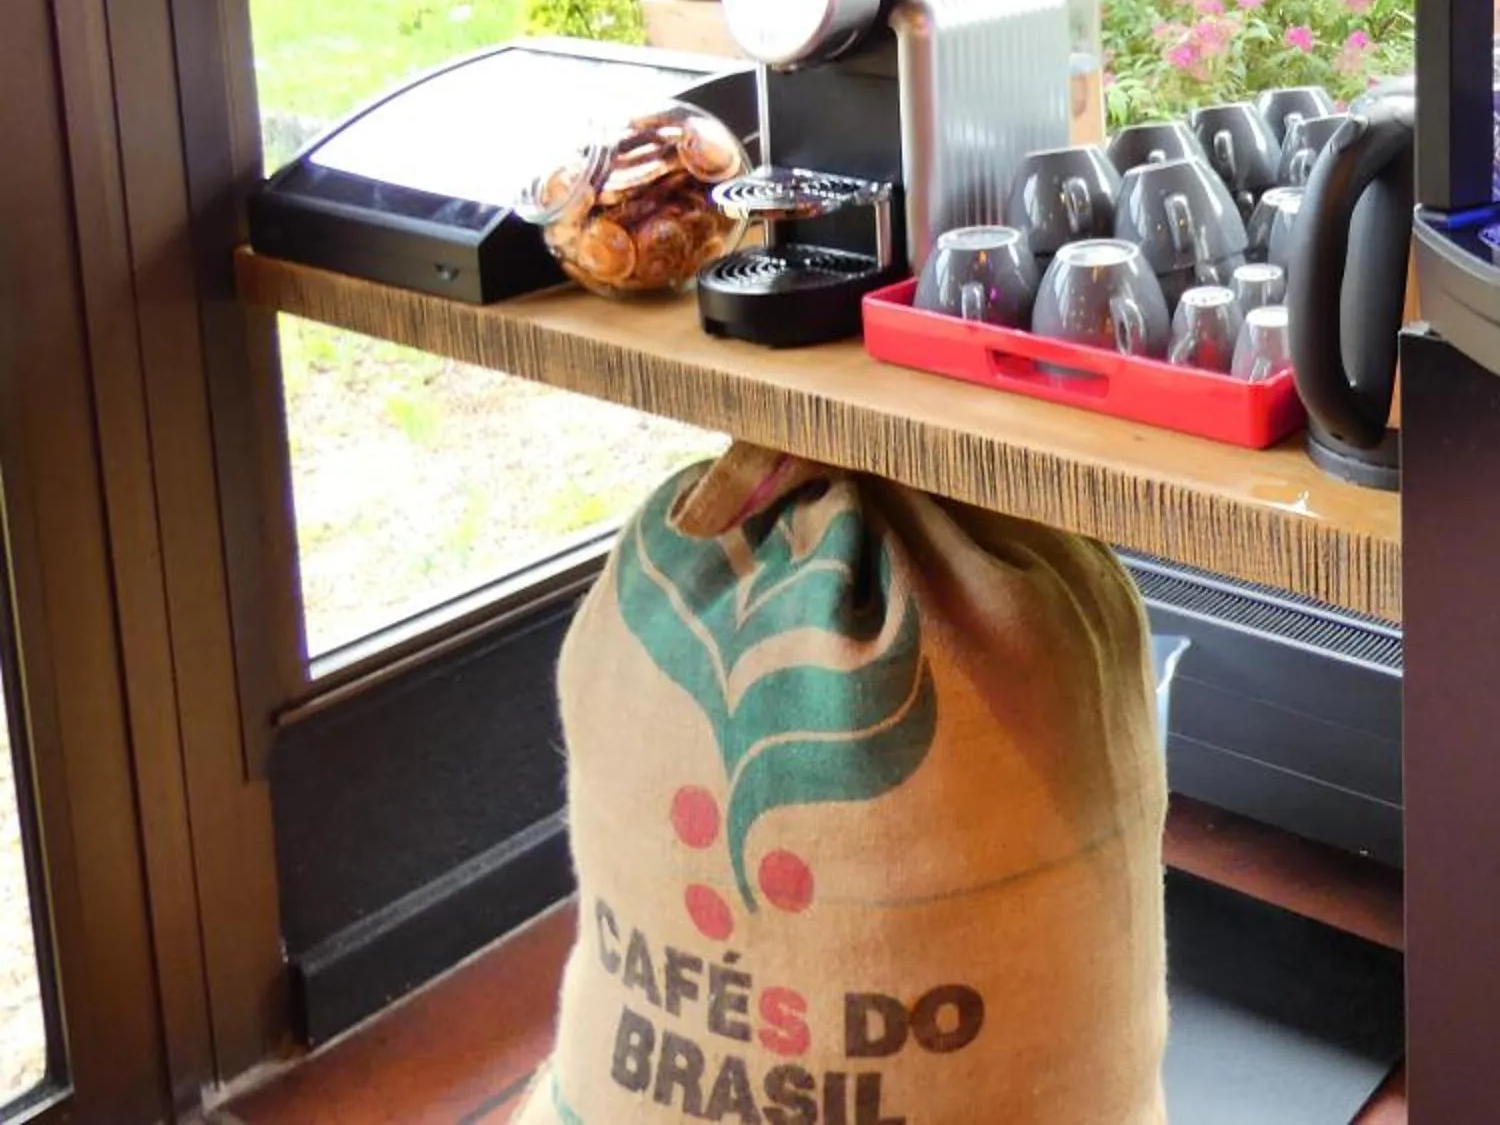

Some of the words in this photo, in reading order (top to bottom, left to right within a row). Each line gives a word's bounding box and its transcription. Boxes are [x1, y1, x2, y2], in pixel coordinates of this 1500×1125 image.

[594, 896, 811, 1058] CAFÉS
[844, 983, 986, 1059] DO
[610, 1005, 907, 1125] BRASIL
